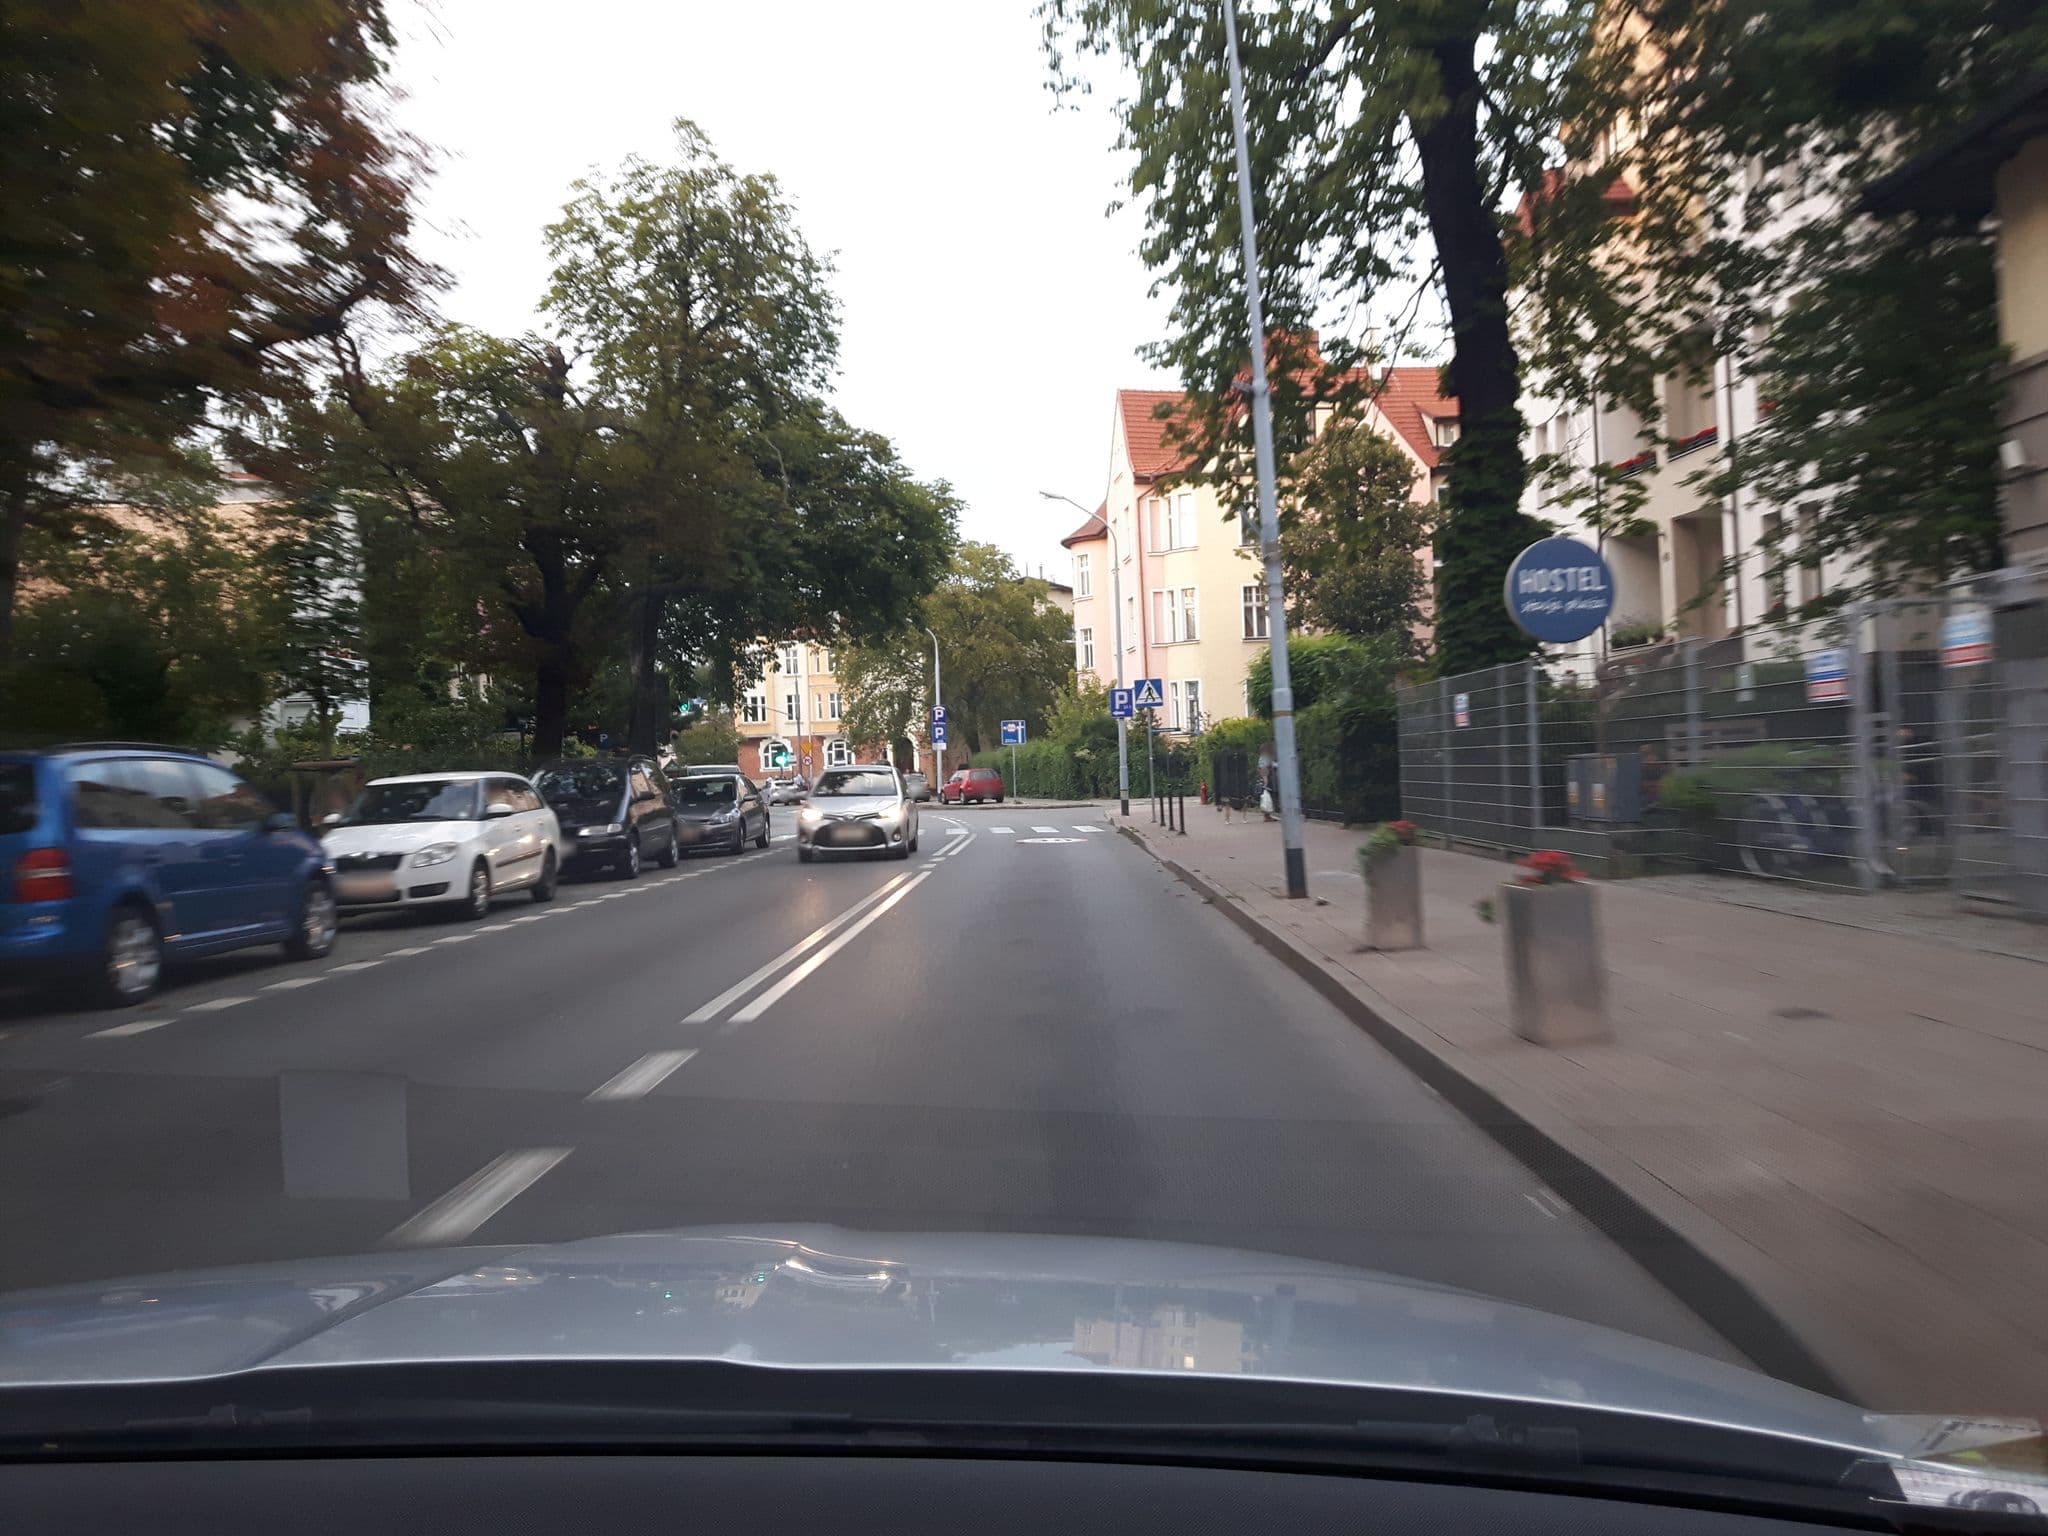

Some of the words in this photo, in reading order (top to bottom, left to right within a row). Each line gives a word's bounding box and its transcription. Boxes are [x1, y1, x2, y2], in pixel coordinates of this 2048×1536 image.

[1518, 566, 1607, 594] HOSTEL
[1115, 691, 1128, 709] P
[935, 710, 944, 721] P
[600, 733, 608, 743] P
[935, 727, 944, 739] P
